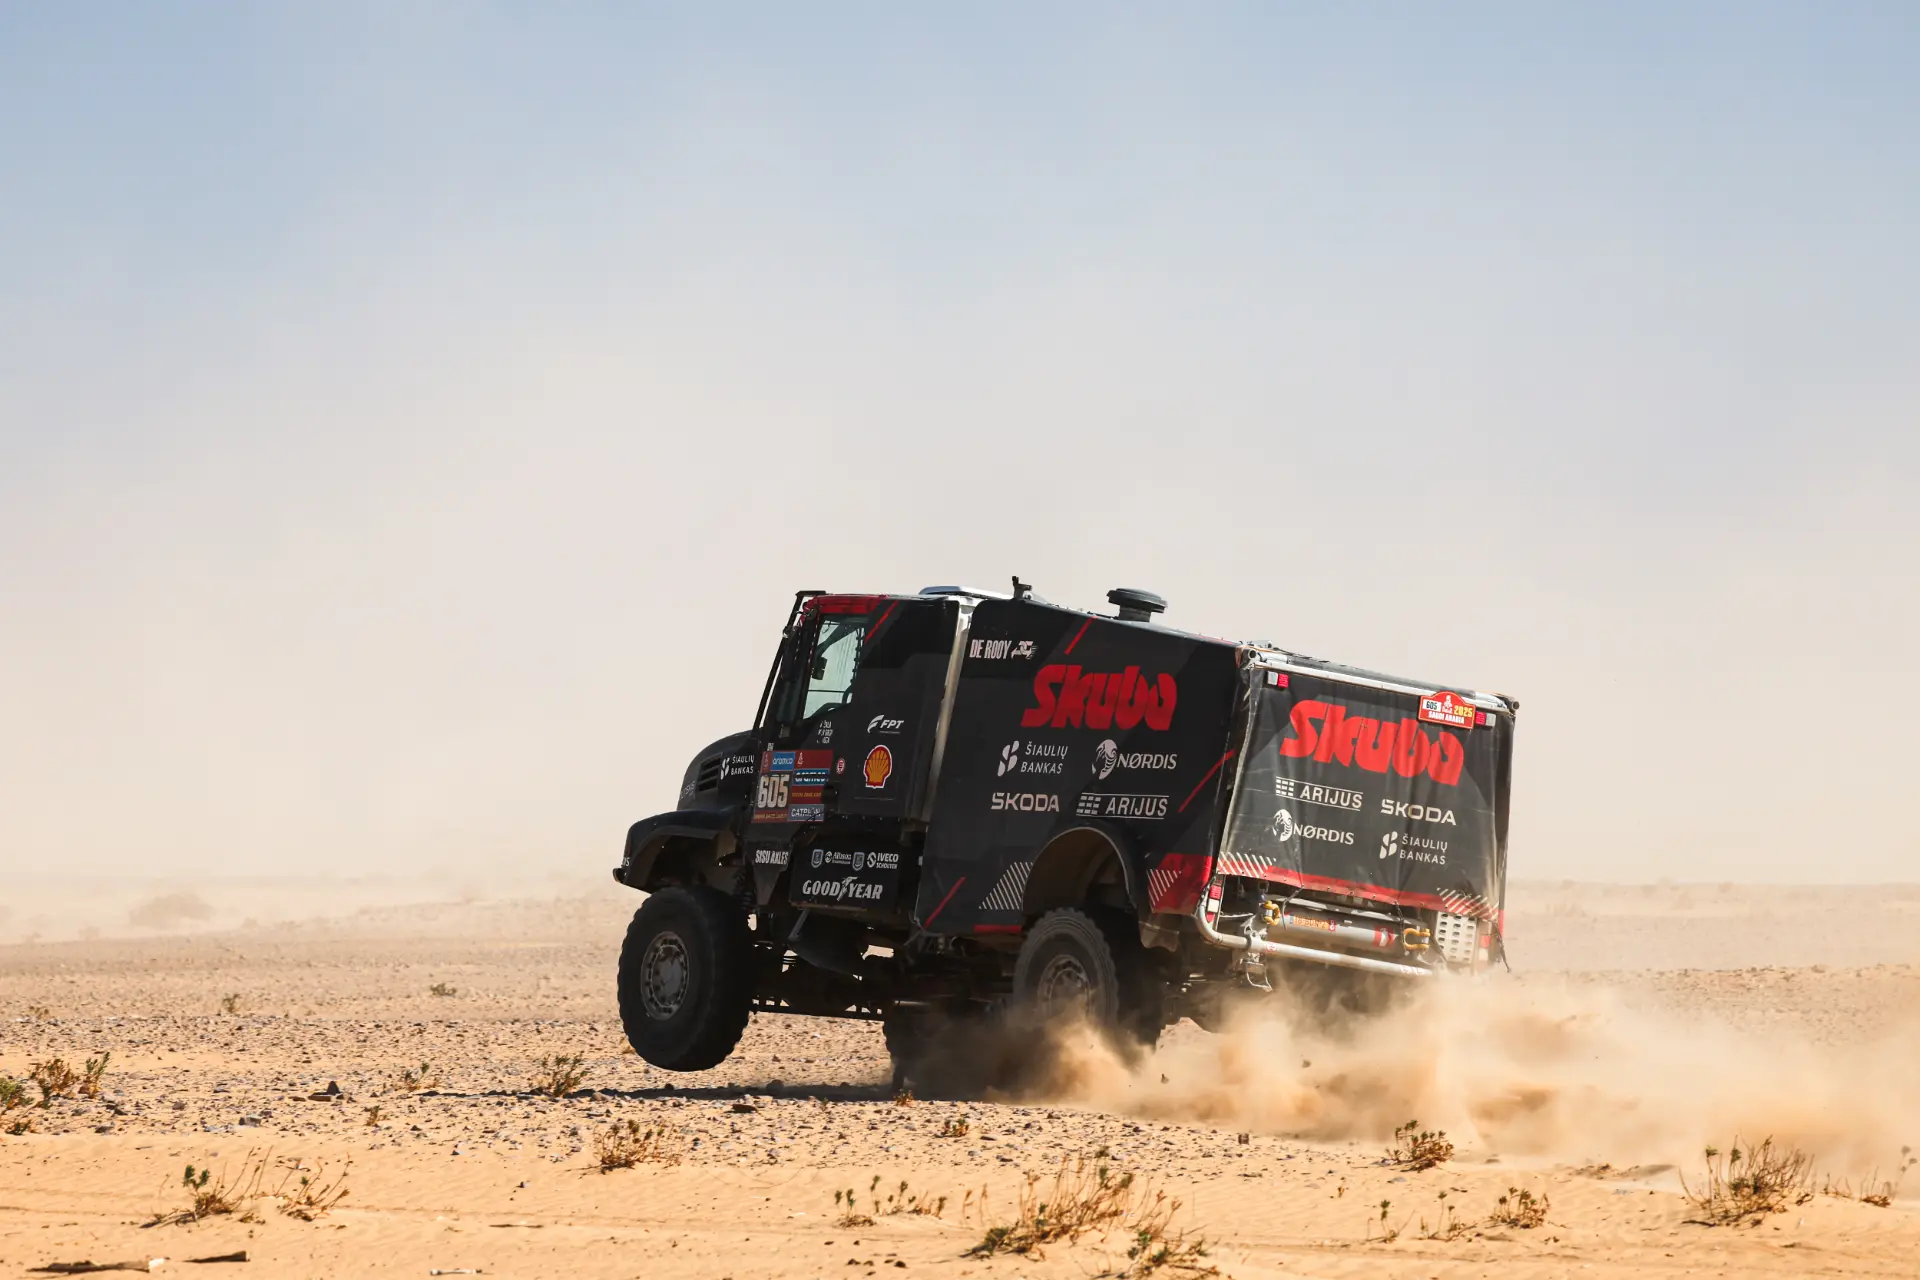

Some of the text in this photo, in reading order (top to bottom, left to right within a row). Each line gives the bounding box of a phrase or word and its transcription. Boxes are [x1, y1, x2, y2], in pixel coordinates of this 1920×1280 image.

[969, 639, 1012, 660] DE ROOY
[1021, 664, 1177, 731] Skuba
[1426, 700, 1438, 710] 605
[1454, 705, 1473, 718] 2025
[880, 719, 904, 729] FPT
[1280, 699, 1464, 787] Skuba
[731, 766, 754, 776] BANKAS
[1021, 761, 1064, 775] BANKAS
[757, 774, 790, 808] 605
[1299, 784, 1363, 809] ARIJUS
[1105, 797, 1169, 817] ARIJUS
[877, 853, 899, 863] IVECO
[1399, 849, 1446, 865] BANKAS
